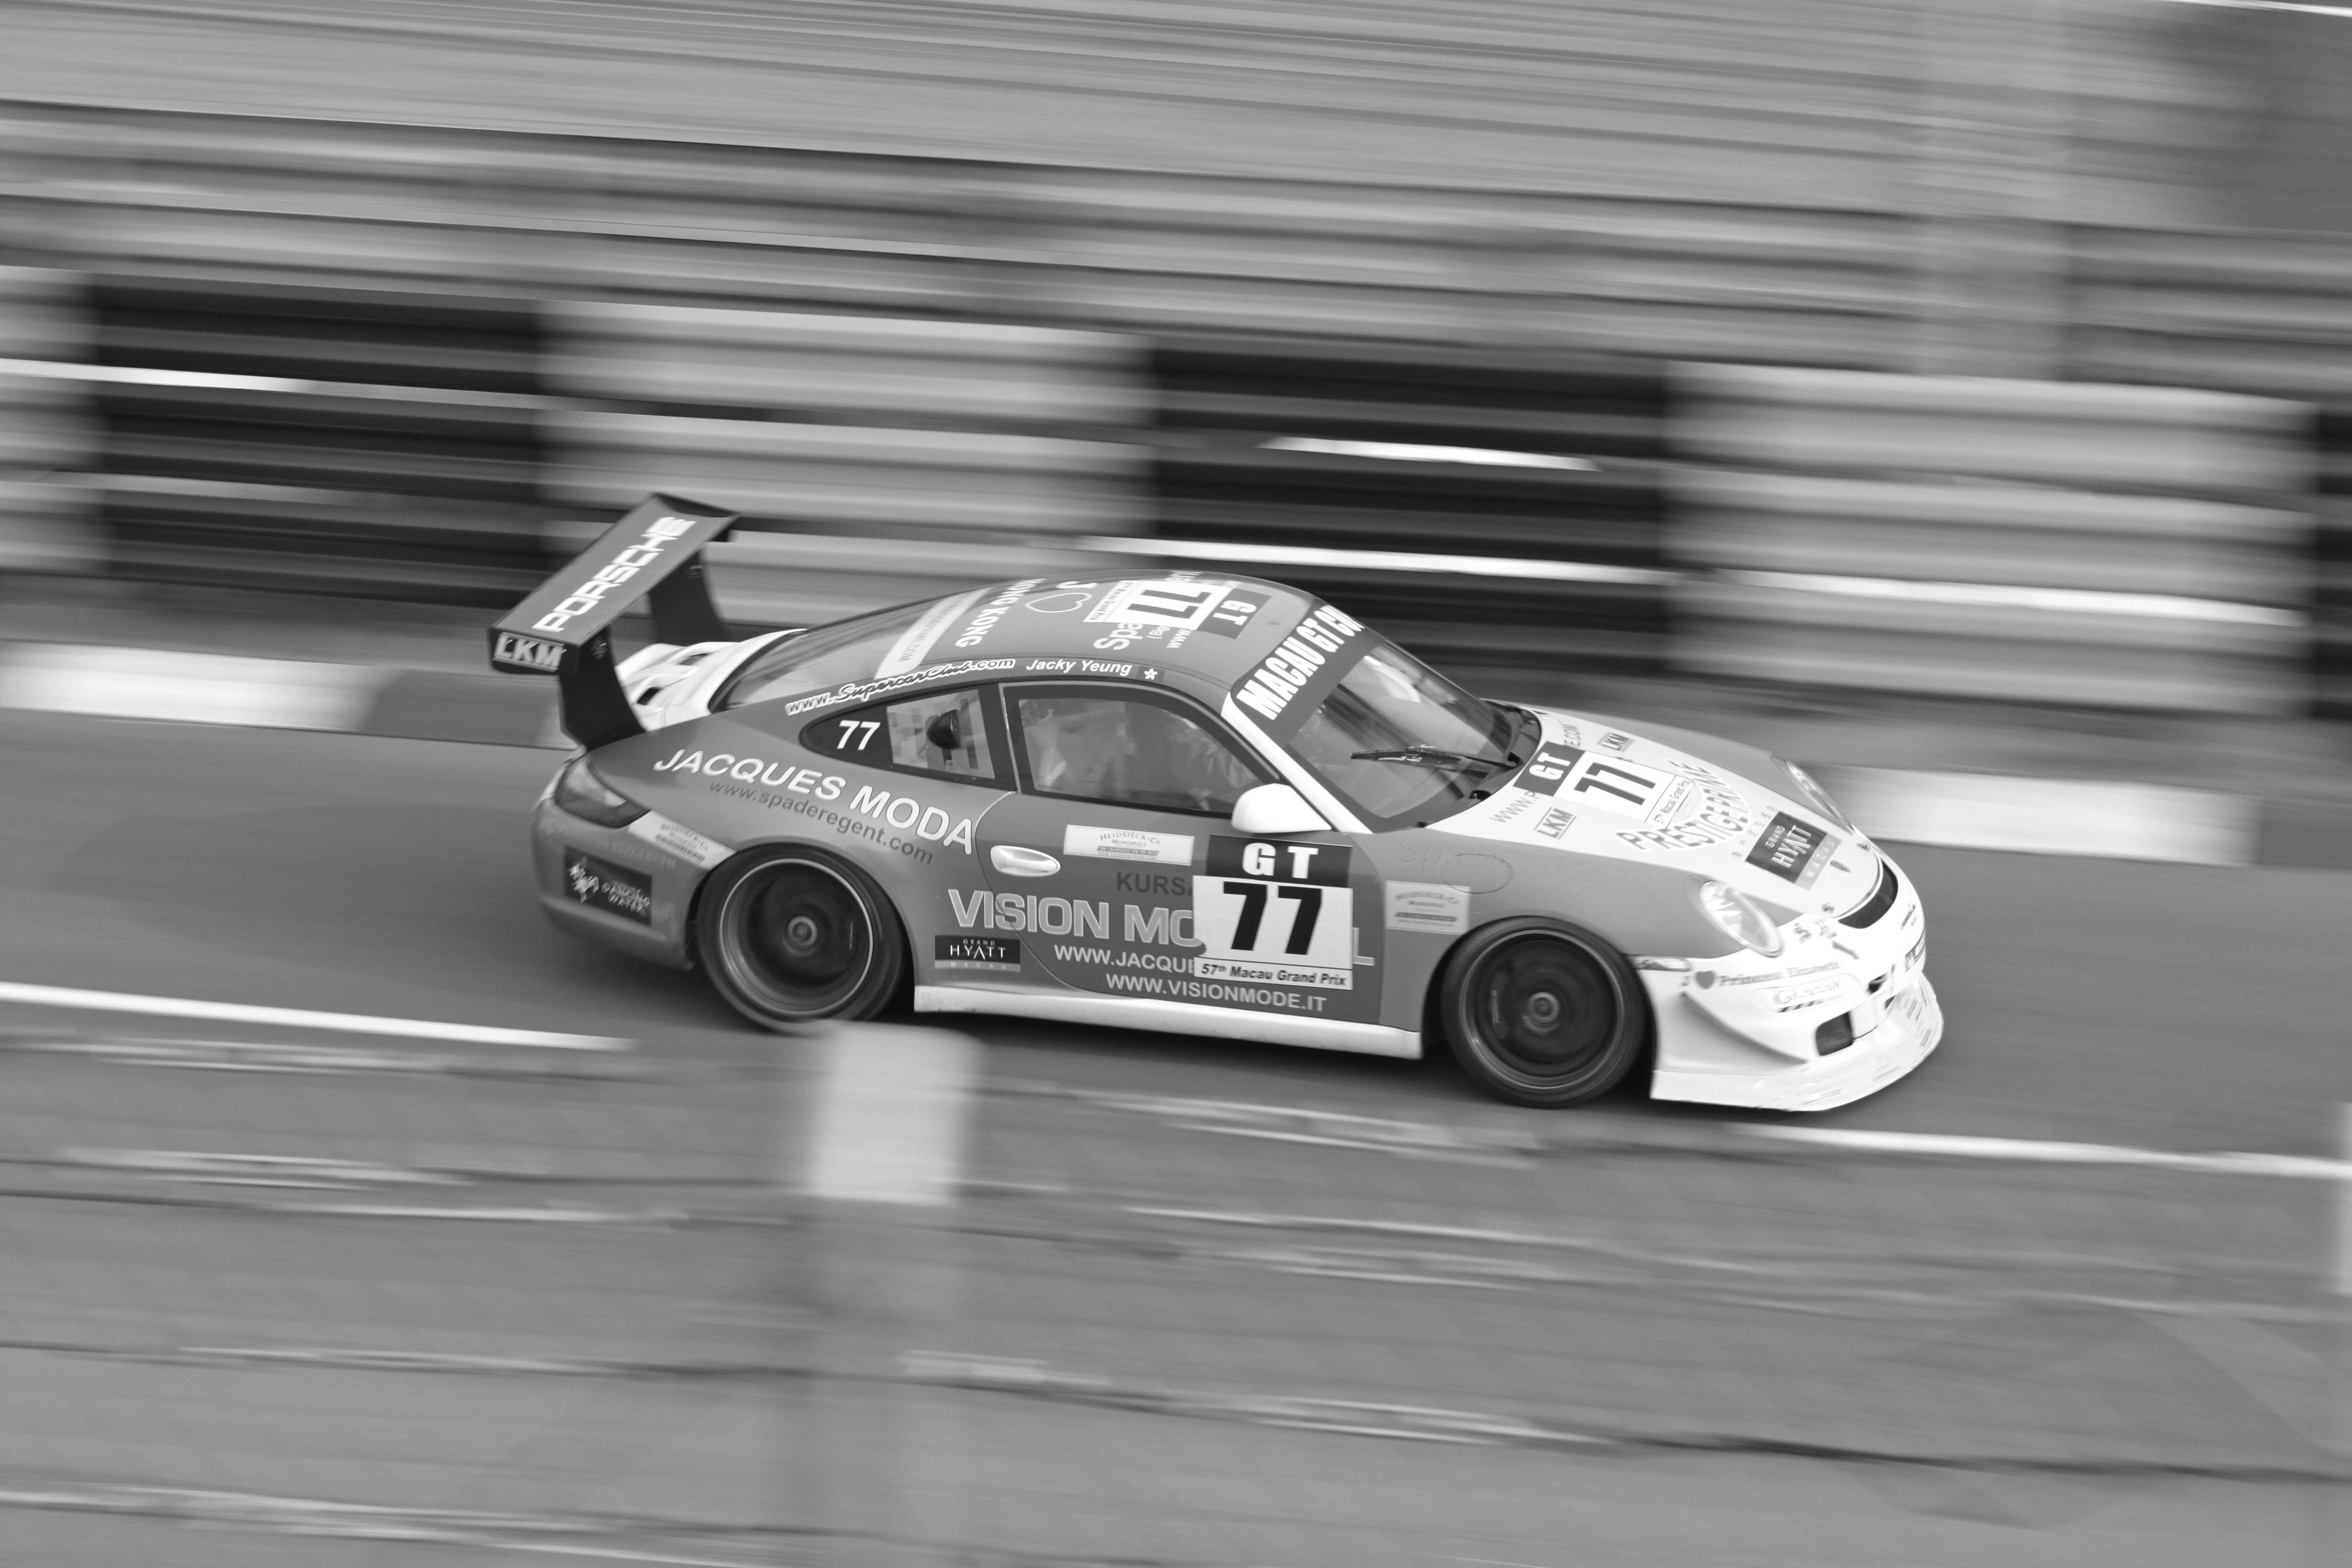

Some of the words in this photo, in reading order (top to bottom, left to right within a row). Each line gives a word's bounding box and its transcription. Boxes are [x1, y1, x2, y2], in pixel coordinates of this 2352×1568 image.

[532, 517, 696, 632] PORSCHE
[990, 578, 1046, 605] HONG
[1127, 589, 1214, 619] 77
[954, 606, 1010, 647] KONG
[1094, 623, 1144, 650] Spa
[495, 636, 564, 669] LKM
[1026, 659, 1077, 674] Jacky
[1081, 660, 1132, 676] Yeung
[1236, 637, 1326, 721] MACAU
[1296, 618, 1345, 653] GT
[785, 658, 1016, 716] www.SupercarClub.com
[836, 720, 881, 751] 77
[1600, 732, 1634, 752] LKM
[1529, 752, 1571, 781] GT
[1573, 762, 1657, 806] 77
[1668, 788, 1686, 800] Grand
[1677, 779, 1691, 789] Prix
[653, 749, 846, 801] JACQUES
[849, 785, 973, 856] MODA
[1660, 801, 1677, 815] Macau
[709, 782, 934, 865] www.spaderegent.com
[1100, 832, 1147, 841] HEIDSIECK
[1536, 807, 1574, 839] LKM
[1615, 804, 1750, 850] PRESTIGE
[1764, 825, 1786, 848] GRAND
[1770, 824, 1812, 868] HYATT
[1396, 838, 1464, 871] Spa
[1533, 851, 1662, 890] Regent
[948, 889, 1110, 939] VISION
[1223, 881, 1323, 956] 77
[950, 944, 1006, 960] HYATT
[1201, 963, 1226, 976] 57th
[1230, 966, 1274, 980] Macau
[1277, 969, 1315, 983] Grand
[1319, 973, 1347, 986] Prix
[1106, 973, 1327, 1012] WWW.VISIONMODE.IT
